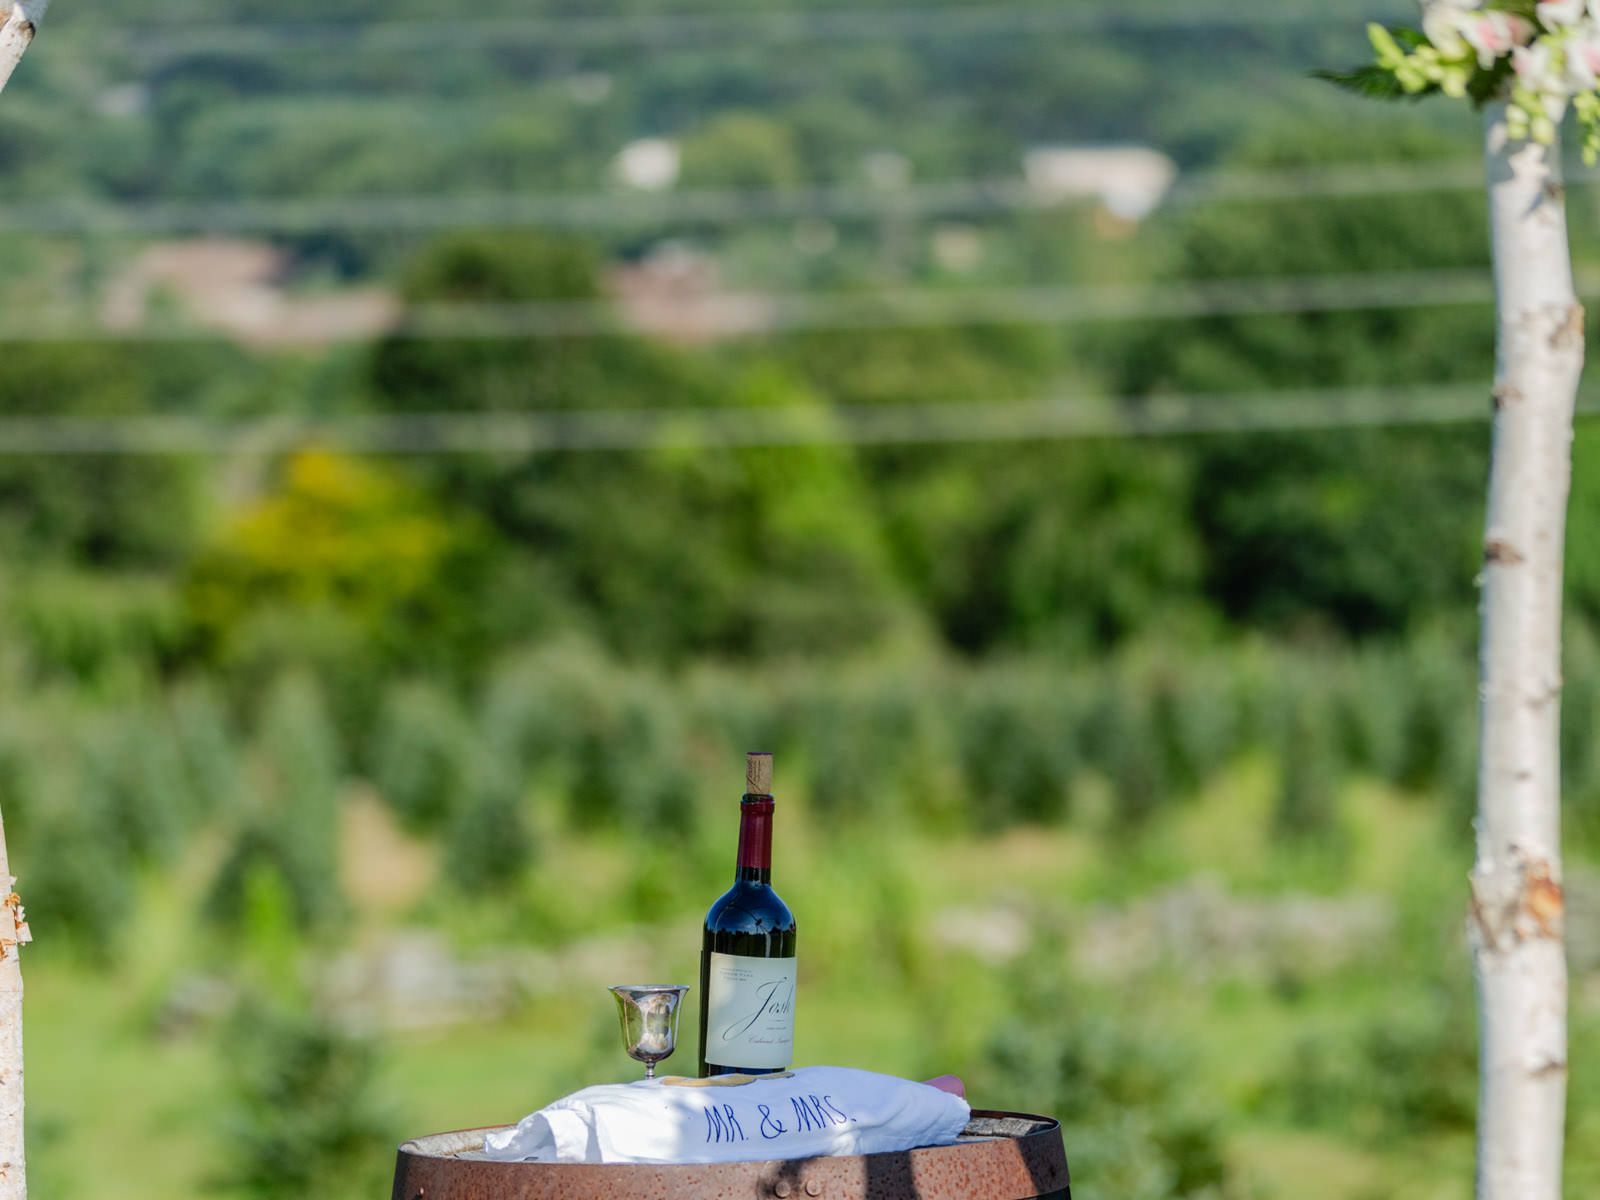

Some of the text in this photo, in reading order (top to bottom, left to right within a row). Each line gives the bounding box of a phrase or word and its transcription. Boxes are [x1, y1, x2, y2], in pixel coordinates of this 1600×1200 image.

[703, 1094, 856, 1143] MR. & MRS.
